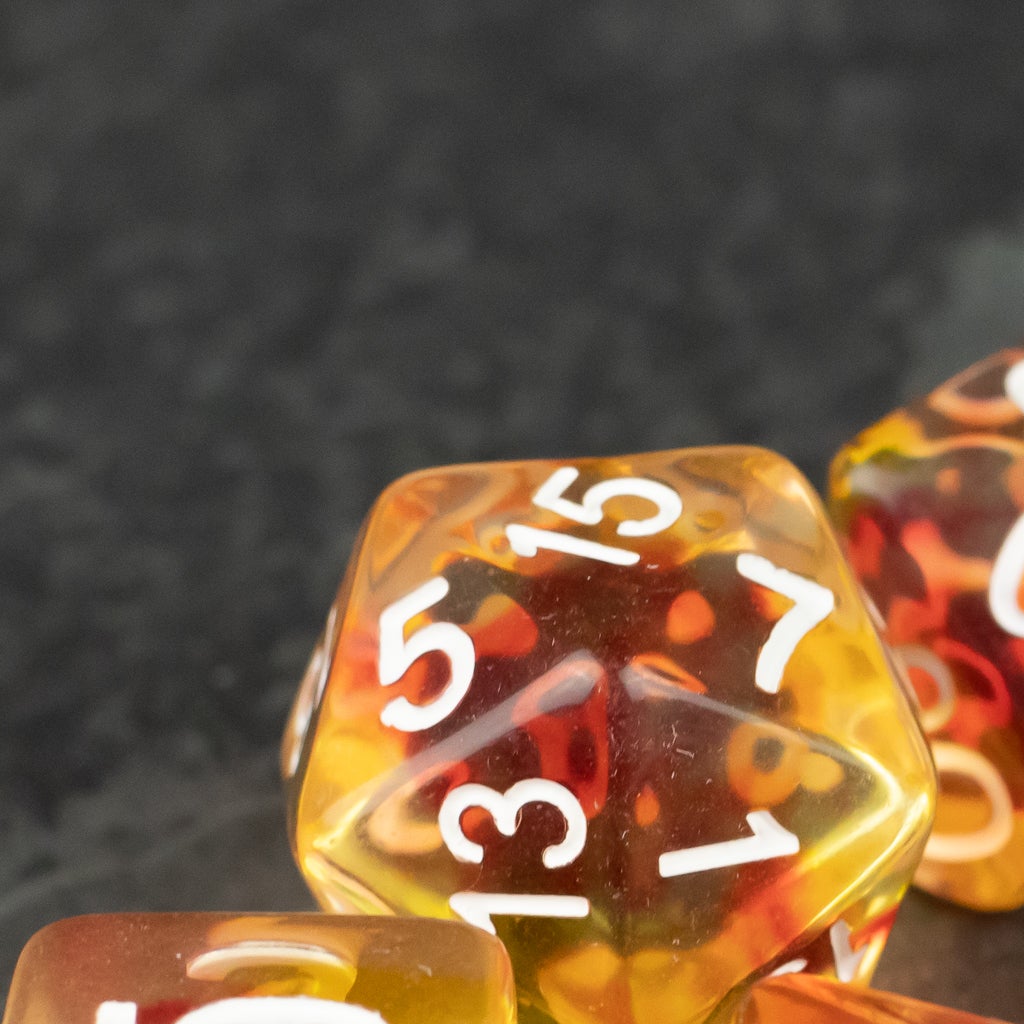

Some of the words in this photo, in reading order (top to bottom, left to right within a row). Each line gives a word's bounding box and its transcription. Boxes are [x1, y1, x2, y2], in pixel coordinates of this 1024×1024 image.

[504, 467, 683, 566] 15
[378, 576, 476, 732] 5
[736, 553, 835, 694] 7
[438, 778, 590, 935] 13
[659, 810, 800, 877] 1
